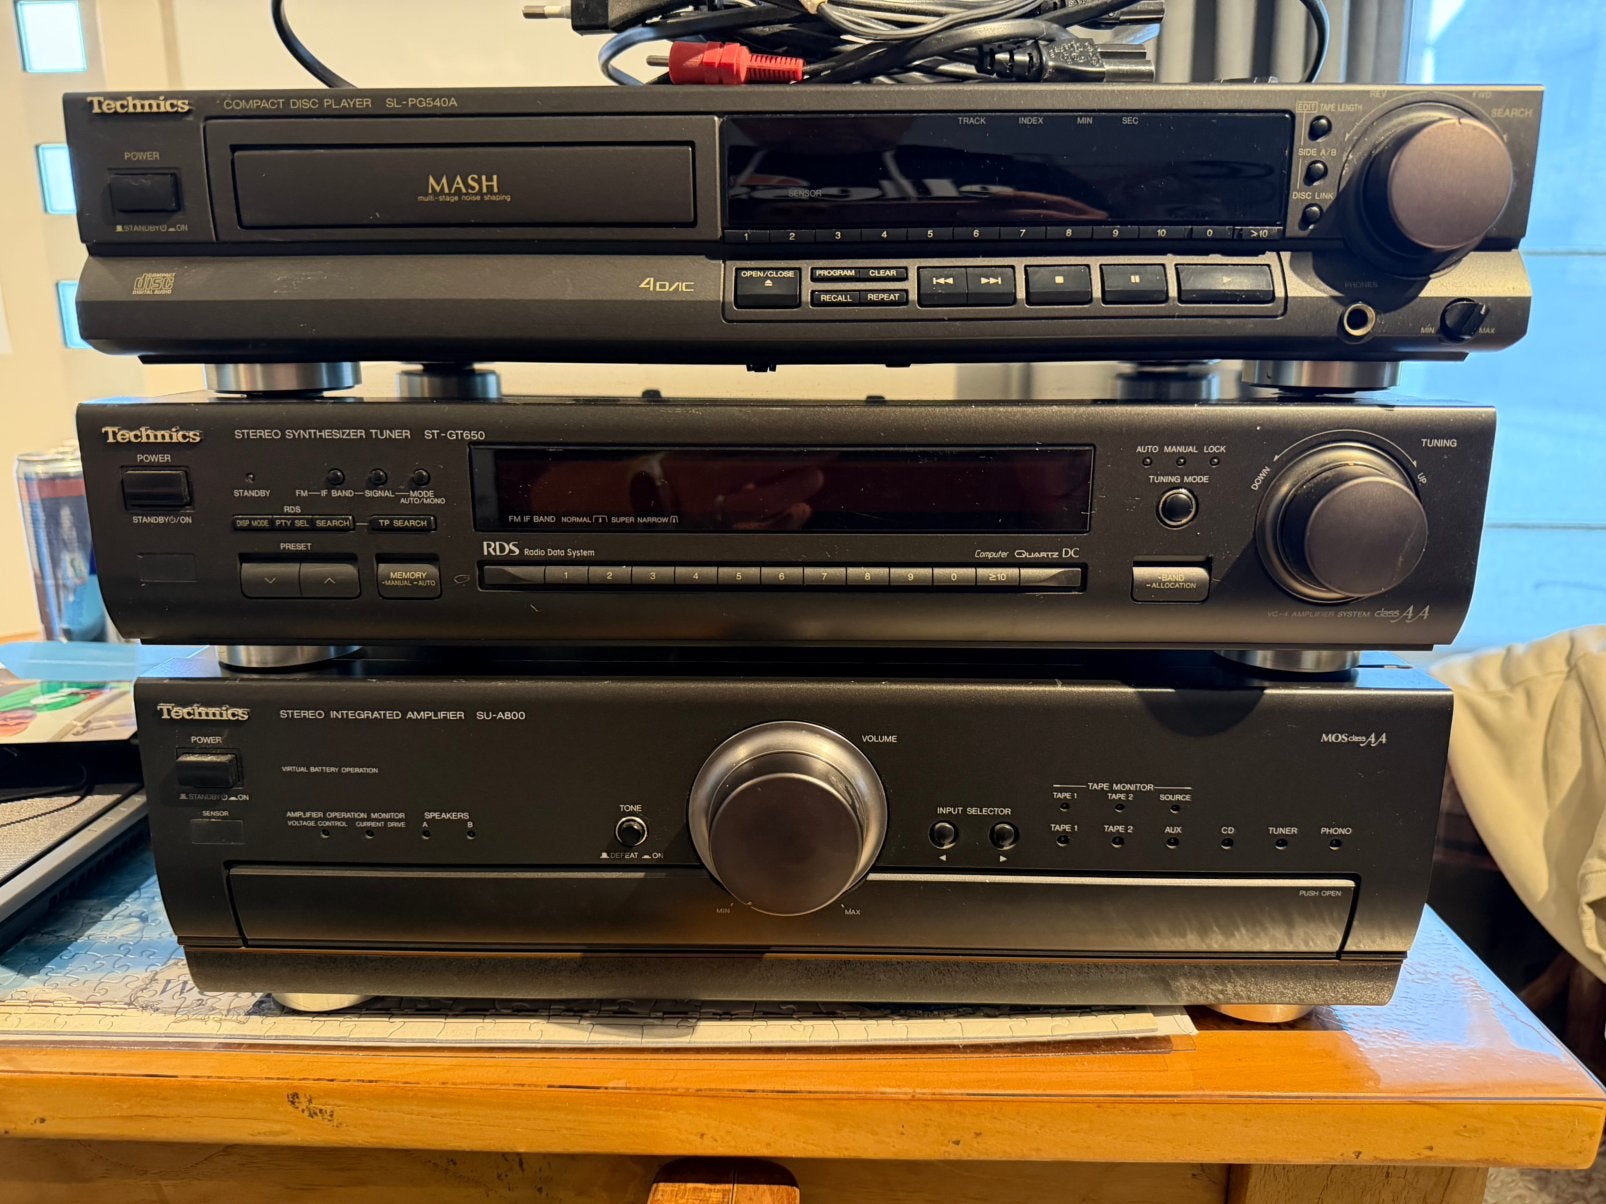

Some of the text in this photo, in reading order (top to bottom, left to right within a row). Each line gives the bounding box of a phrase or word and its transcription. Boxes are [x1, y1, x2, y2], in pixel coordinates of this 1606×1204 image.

[86, 95, 190, 114] Technics
[223, 97, 458, 110] COMPACT DISC PLAYER SL-PG540A
[1320, 103, 1336, 112] TAPE
[1337, 103, 1363, 112] LENGTH
[1490, 109, 1533, 118] SEARCH
[958, 116, 986, 125] TRACK
[1018, 116, 1044, 125] INDEX
[1076, 116, 1093, 125] MIN
[1122, 116, 1139, 125] SEC
[124, 151, 160, 161] POWER
[1298, 148, 1337, 156] SIDE A/B
[427, 174, 500, 194] MASH
[788, 189, 822, 198] SENSOR
[1292, 191, 1334, 200] DISC LINK
[417, 194, 512, 203] multi-stage noise shaping
[176, 223, 189, 232] ON
[743, 228, 1268, 241] 1 2 3 4 5 6 7 8 9 10 0 >10
[741, 270, 795, 278] OPEN/CLOSE
[816, 269, 855, 277] PROGRAM
[869, 269, 897, 277] CLEAR
[1344, 281, 1378, 289] PHONES
[820, 294, 853, 302] RECALL
[867, 293, 900, 301] REPEAT
[102, 426, 203, 444] Technics
[234, 429, 486, 441] STEREO SYNTHESIZER TUNER ST-GT650
[1421, 438, 1458, 448] TUNING
[1136, 445, 1159, 453] AUTO
[1163, 445, 1198, 454] MANUAL
[1203, 445, 1227, 454] LOCK
[137, 454, 171, 463] POWER
[1148, 475, 1210, 484] TUNING MODE
[1250, 465, 1271, 492] DOWN
[1416, 472, 1427, 485] UP
[233, 489, 271, 497] STANDBY
[364, 490, 395, 498] SIGNAL
[409, 490, 435, 498] MODE
[400, 497, 446, 505] AUTO/MONO
[283, 505, 302, 513] RDS
[275, 519, 310, 528] PTY SEL
[315, 519, 350, 528] SEARCH
[379, 519, 428, 527] TP SEARCH
[508, 515, 557, 523] FM IF BAND
[611, 516, 669, 524] SUPER NARROW
[280, 542, 313, 551] PRESET
[482, 541, 595, 559] RDS Radio Data System
[974, 549, 1010, 560] Computer
[1062, 547, 1080, 559] DC
[390, 571, 428, 580] MEMORY
[606, 572, 613, 580] 2
[650, 572, 657, 580] 3
[692, 572, 700, 581] 4
[735, 572, 742, 581] 5
[778, 572, 785, 581] 6
[821, 572, 828, 581] 7
[864, 572, 871, 581] 8
[907, 573, 914, 581] 9
[951, 573, 958, 581] 0
[1374, 608, 1401, 618] class
[157, 703, 250, 721] Technics
[280, 709, 526, 721] STEREO INTEGRATED AMPLIFIER SU-A800
[191, 736, 222, 744] POWER
[861, 735, 898, 743] VOLUME
[1320, 732, 1349, 743] MOS
[1087, 782, 1155, 792] TAPE MONITOR
[1159, 793, 1192, 802] SOURCE
[618, 804, 643, 813] TONE
[937, 806, 1013, 816] INPUT SELECTOR
[286, 811, 406, 820] AMPLIFIER OPERATION MONITOR
[424, 812, 470, 820] SPEAKERS
[317, 820, 349, 828] CONTROL
[1050, 823, 1071, 832] TAPE
[1104, 825, 1134, 833] TAPE 2
[1164, 826, 1183, 834] AUX
[1221, 826, 1235, 835] CD
[1268, 827, 1299, 835] TUNER
[1320, 827, 1353, 836] PHONO
[1321, 890, 1342, 898] OPEN
